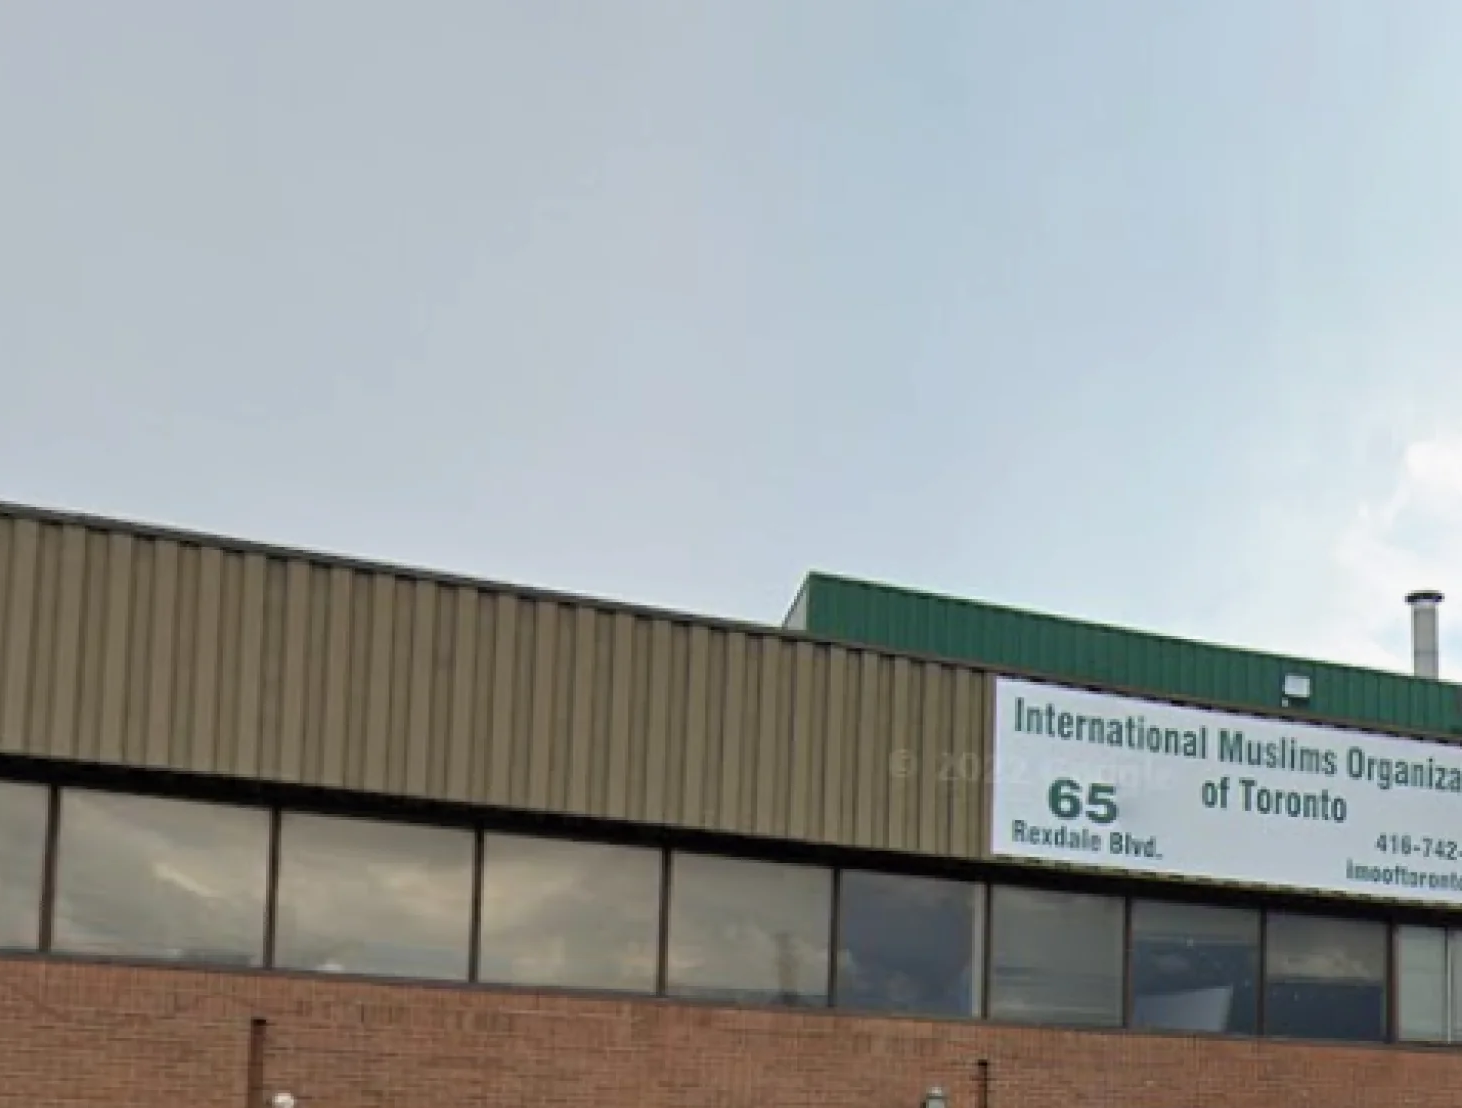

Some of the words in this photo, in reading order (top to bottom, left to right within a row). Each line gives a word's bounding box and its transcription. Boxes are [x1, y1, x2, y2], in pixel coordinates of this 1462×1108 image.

[1013, 696, 1207, 760] International
[1217, 727, 1338, 777] Muslims
[1047, 776, 1120, 824] 65
[1201, 776, 1230, 809] of
[1239, 777, 1348, 824] Toronto
[1011, 819, 1103, 852] Rexdale
[1109, 830, 1165, 861] Blvd.
